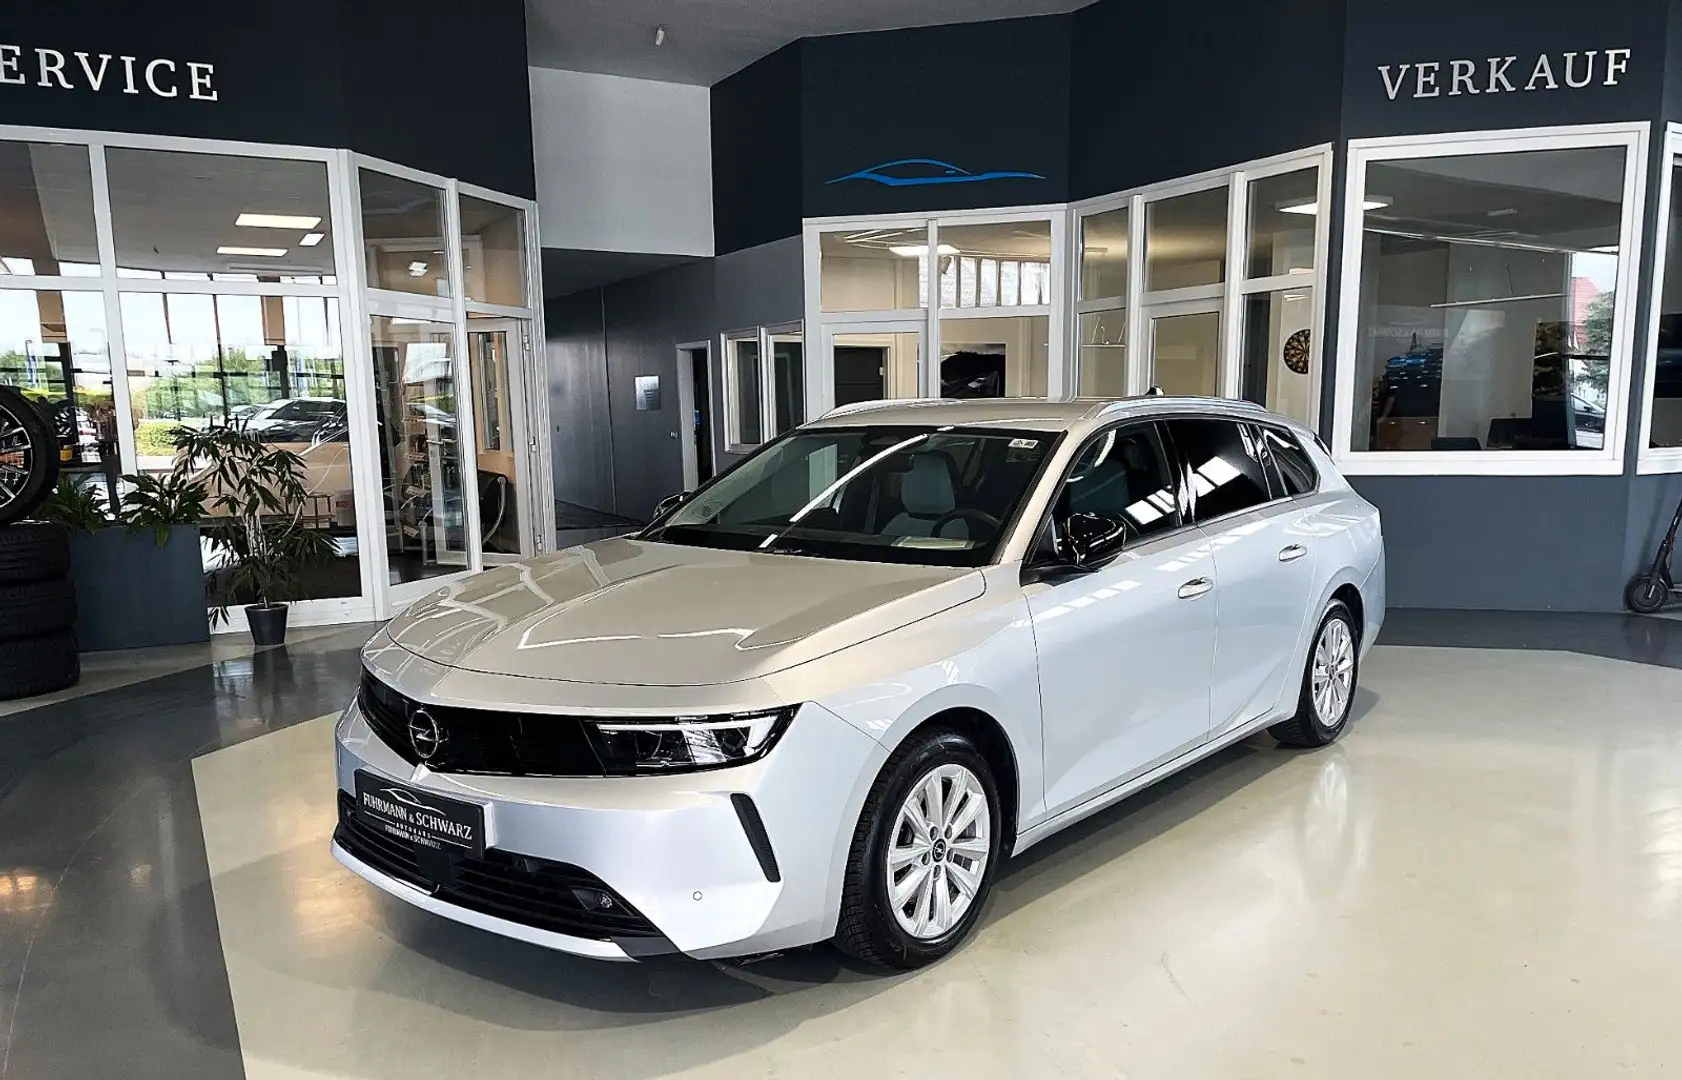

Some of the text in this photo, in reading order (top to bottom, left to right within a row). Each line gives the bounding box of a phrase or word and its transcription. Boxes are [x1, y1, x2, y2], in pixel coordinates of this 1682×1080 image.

[0, 44, 218, 101] ERVICE
[1377, 48, 1631, 100] VERKAUF
[363, 792, 473, 840] FUHRMANN & SCHWARZ
